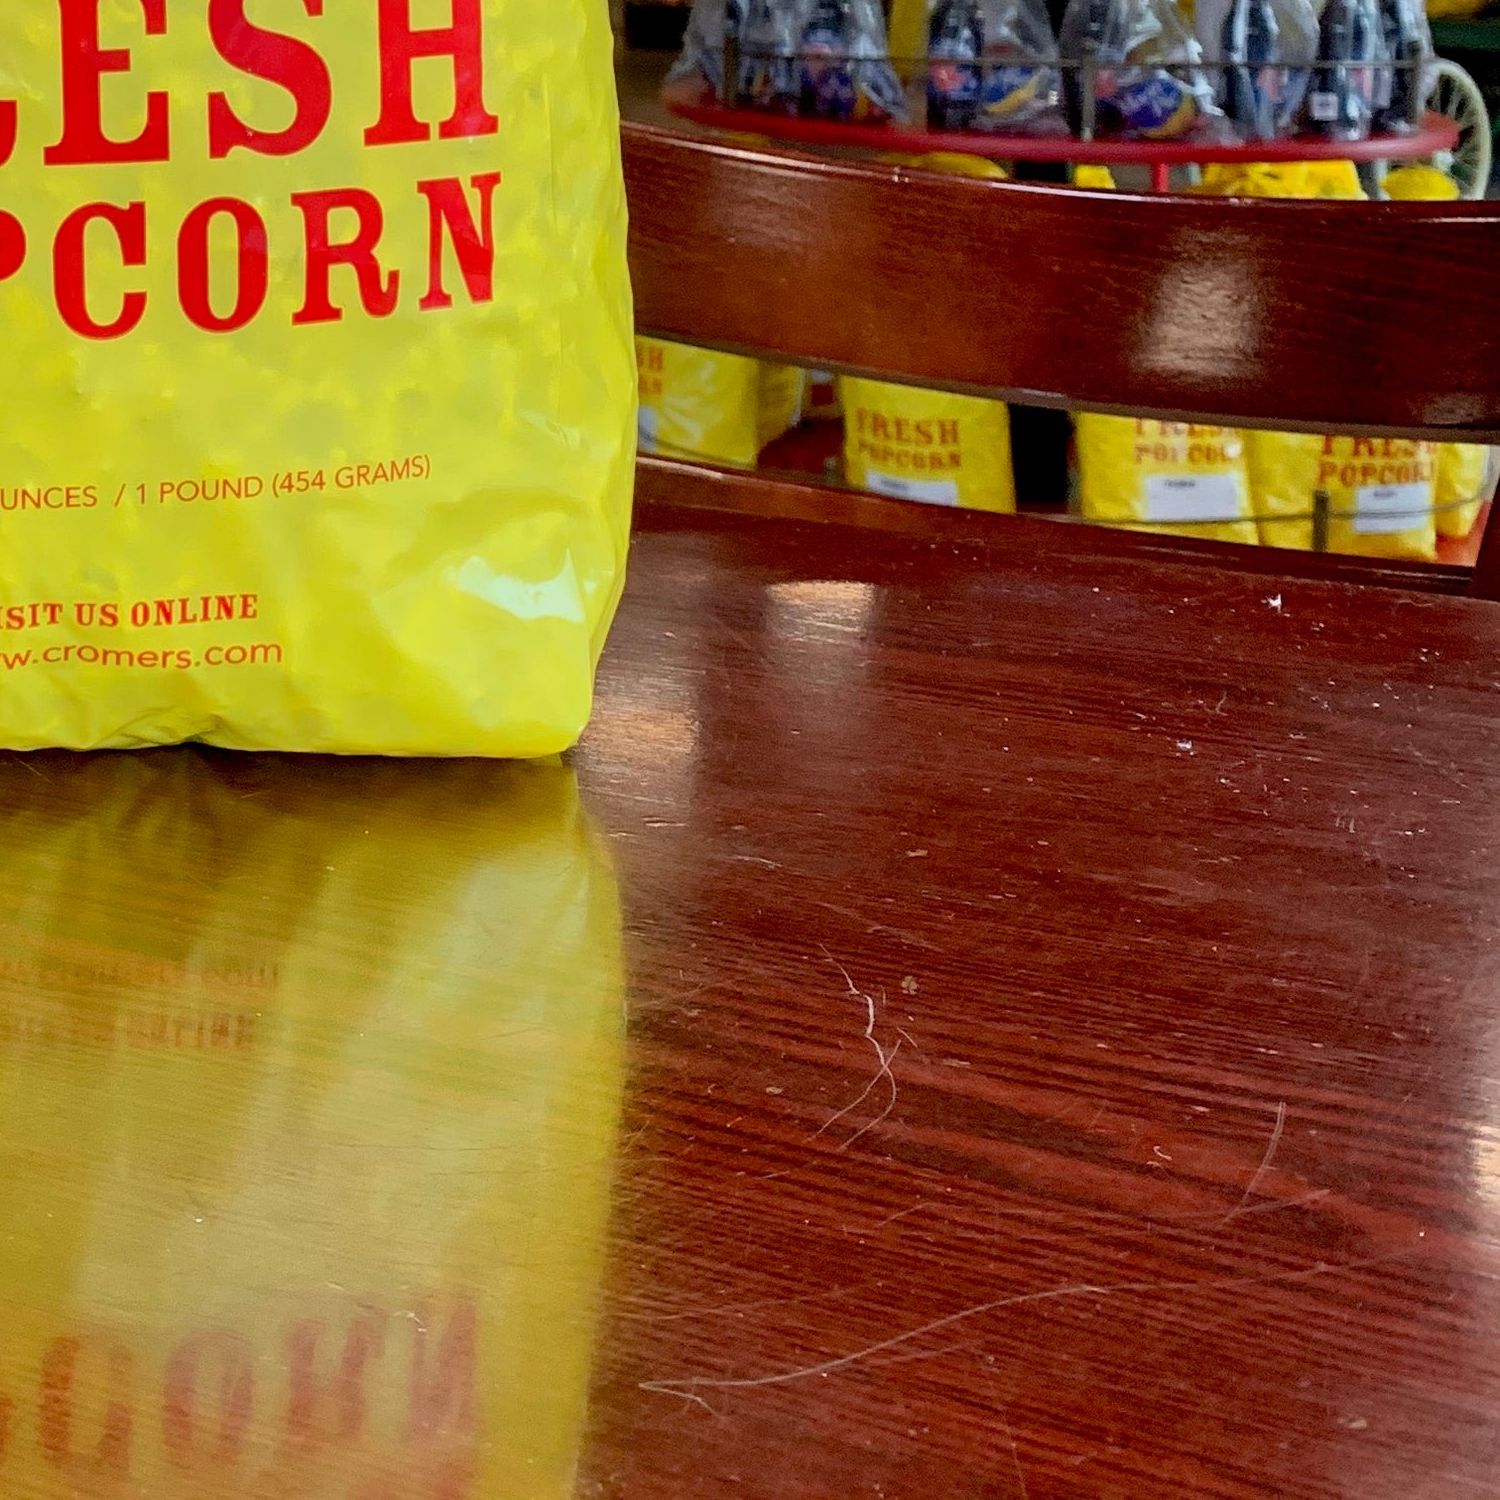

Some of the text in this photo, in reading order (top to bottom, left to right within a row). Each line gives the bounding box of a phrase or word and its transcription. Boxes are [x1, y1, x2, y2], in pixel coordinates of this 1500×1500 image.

[135, 483, 148, 506] 1
[158, 475, 264, 504] POUND
[270, 470, 327, 501] (454
[333, 453, 432, 491] GRAMS)
[74, 601, 119, 628] US
[130, 592, 259, 628] ONLINE
